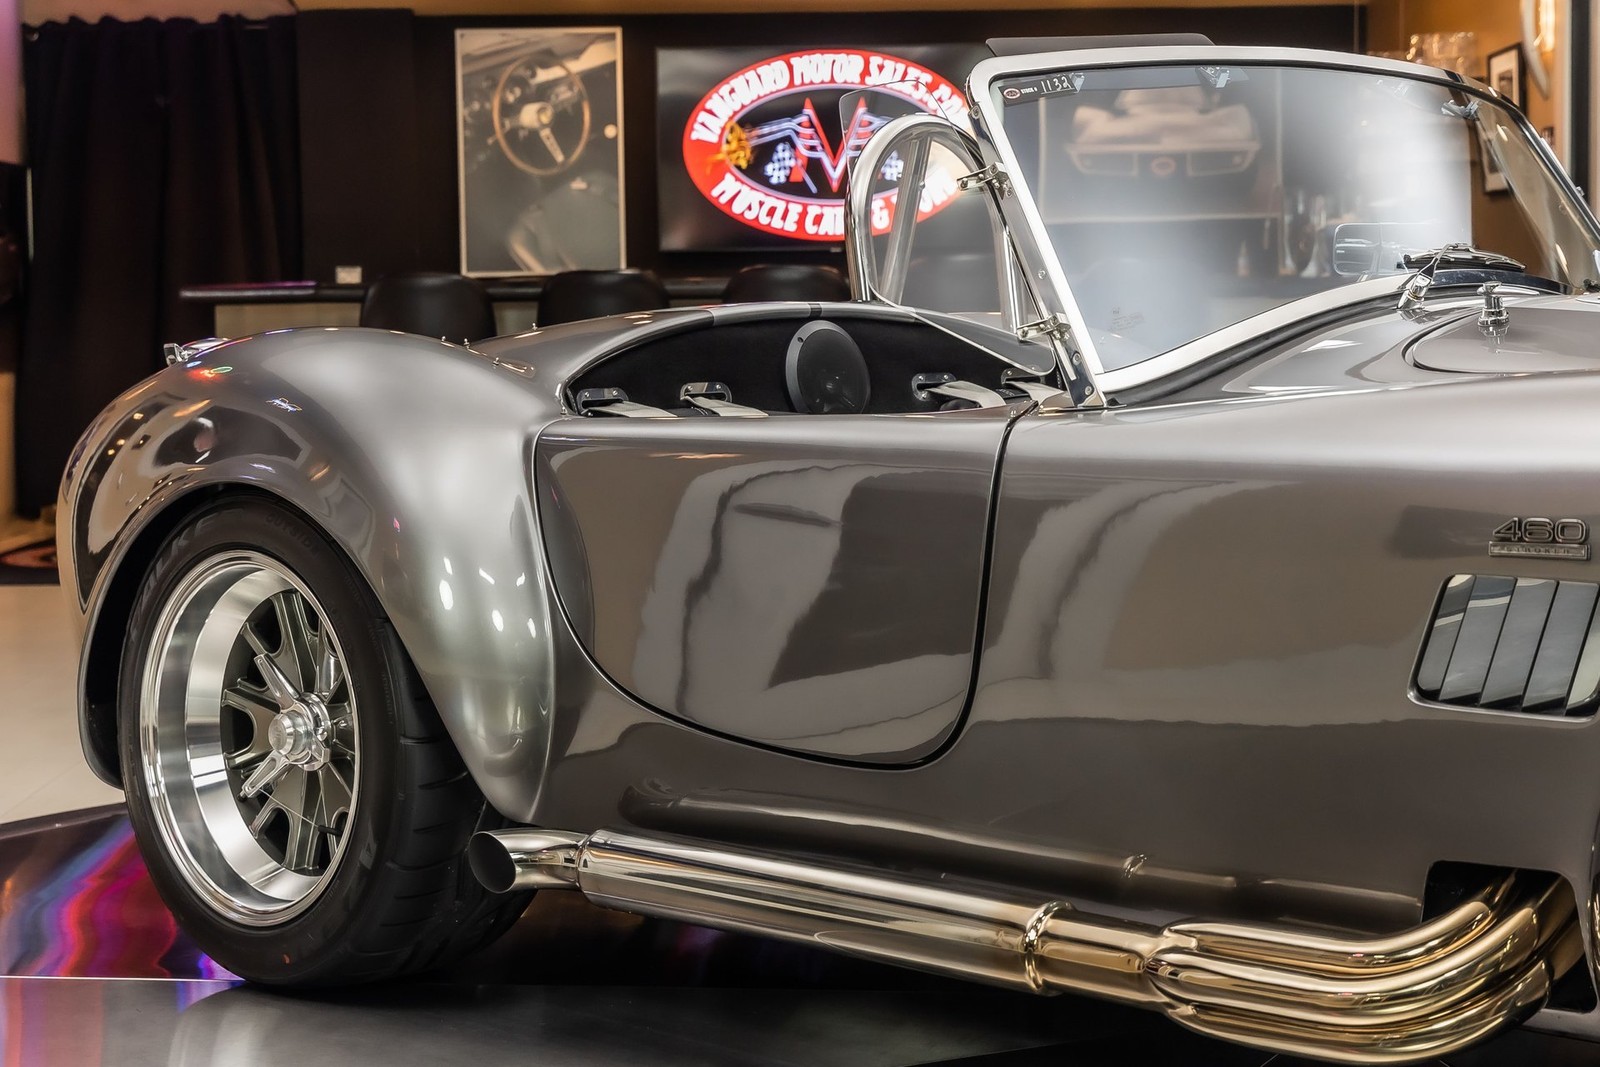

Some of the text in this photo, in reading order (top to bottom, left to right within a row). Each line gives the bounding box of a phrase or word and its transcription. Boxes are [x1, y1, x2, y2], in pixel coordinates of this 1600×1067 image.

[690, 60, 790, 144] VANGUARD
[791, 53, 864, 85] MOTOR
[1041, 76, 1071, 92] 1132
[711, 172, 803, 232] MUSCLE
[1493, 517, 1586, 543] 460
